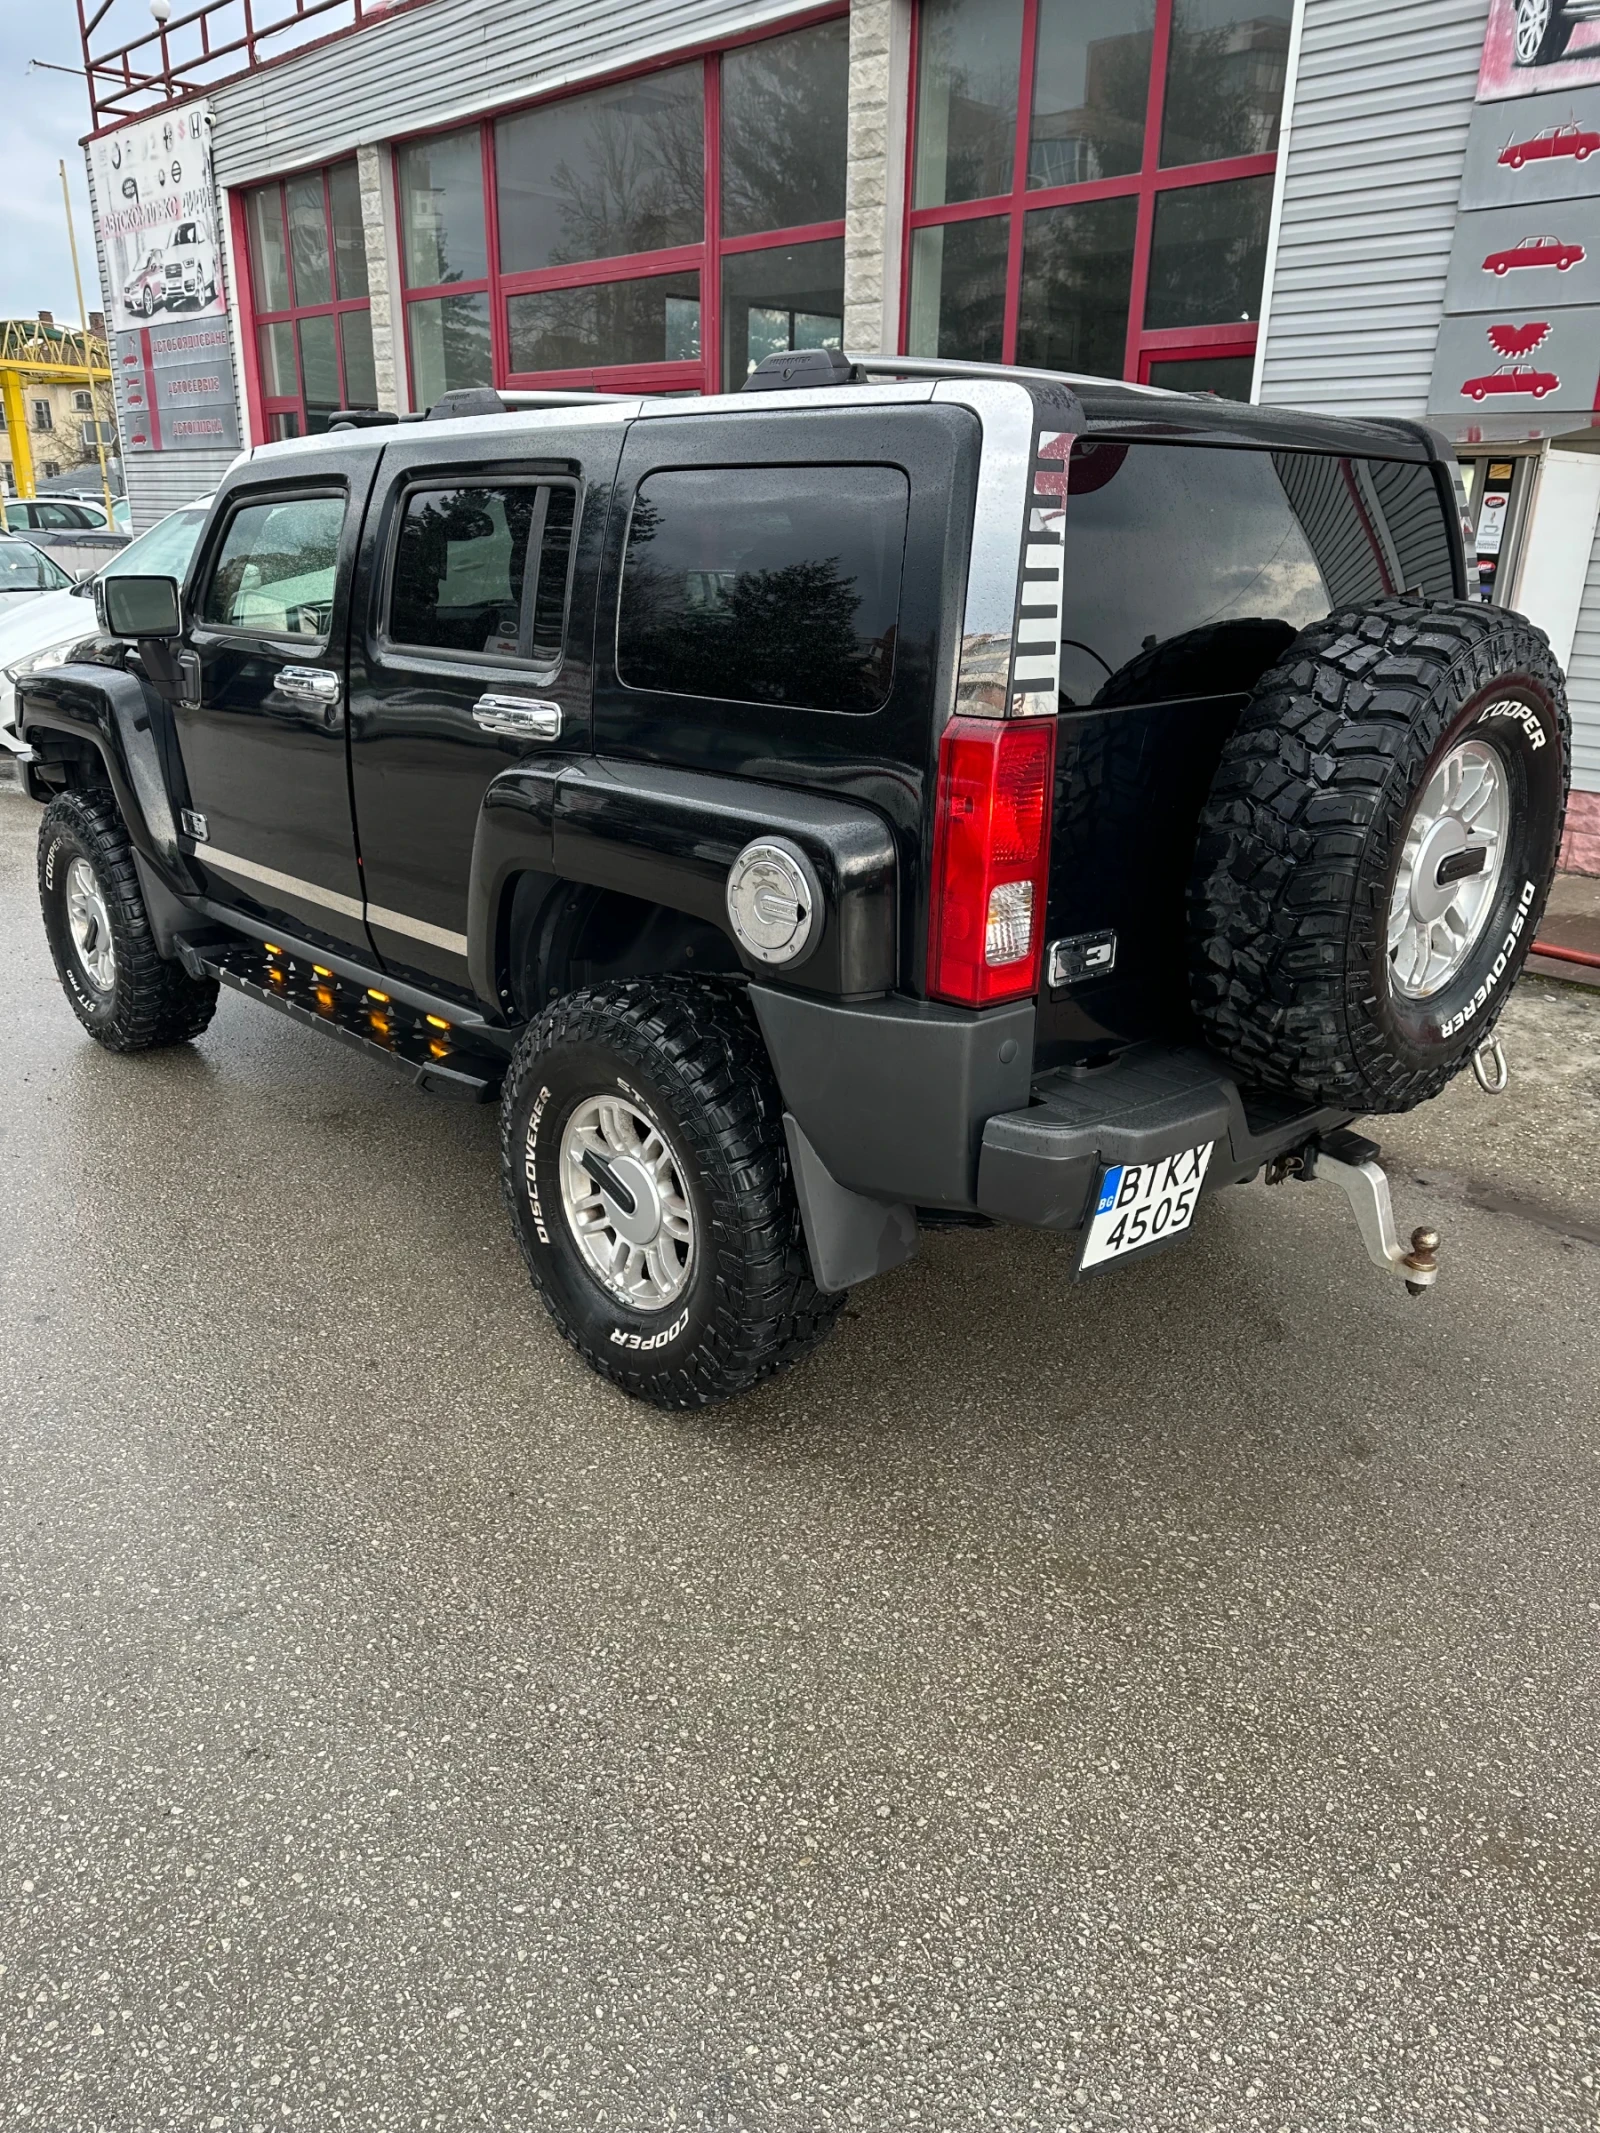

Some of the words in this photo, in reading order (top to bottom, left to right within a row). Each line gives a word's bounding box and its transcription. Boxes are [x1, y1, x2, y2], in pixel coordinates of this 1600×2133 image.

[152, 330, 227, 355] АВТОБОЯДИСВАНЕ
[167, 376, 220, 396] АВТОСЕРВИЗ
[172, 419, 224, 436] АВТОМИВКА
[1477, 700, 1547, 750] COOPER
[45, 836, 64, 891] COOPER
[1441, 881, 1536, 1039] DISCOVERER
[66, 969, 81, 992] PRO
[77, 993, 97, 1013] STT
[524, 1085, 552, 1244] DISCOVERER
[1098, 1195, 1114, 1211] BG
[1106, 1187, 1195, 1251] 4505
[610, 1307, 689, 1351] COOPER
